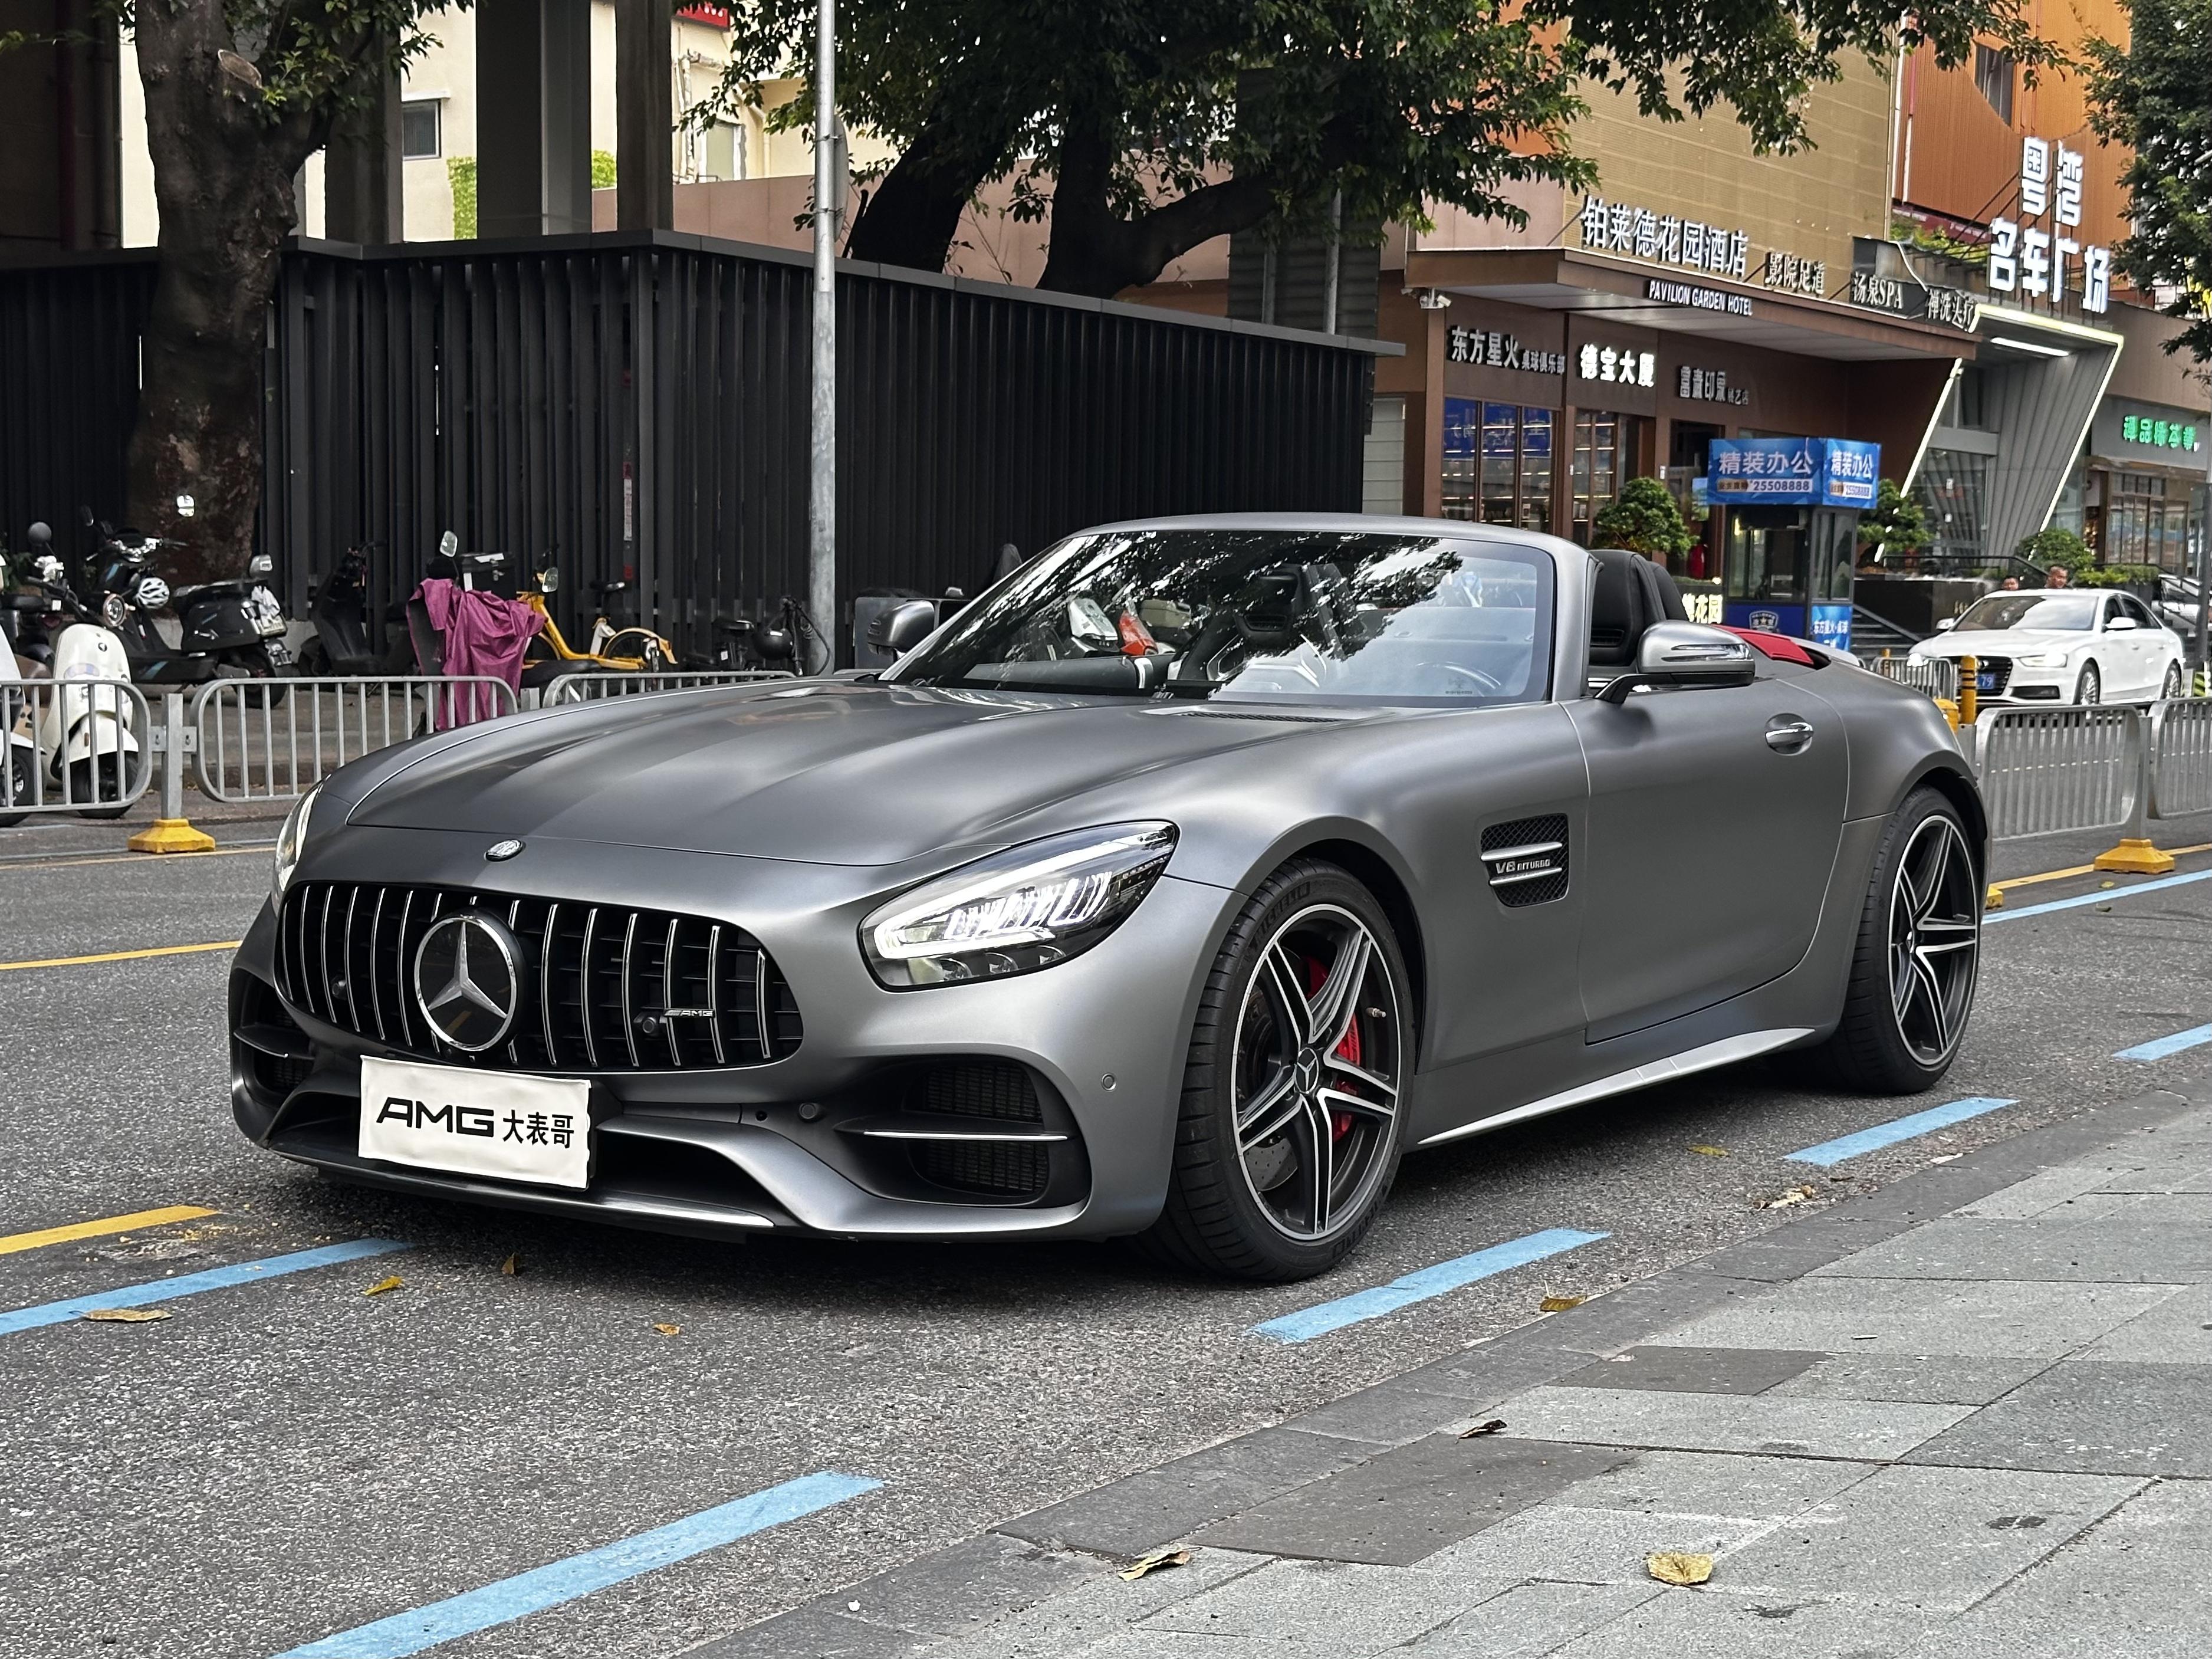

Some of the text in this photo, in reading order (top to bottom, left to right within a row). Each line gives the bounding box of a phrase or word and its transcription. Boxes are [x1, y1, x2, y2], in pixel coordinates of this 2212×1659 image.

[2022, 136, 2083, 227] 粤湾
[1584, 195, 1748, 278] 铂莱德花园酒店
[1764, 254, 1825, 294] 影院足道
[1990, 216, 2111, 314] 名车广场
[1649, 280, 1753, 316] PAVILION GARDEN HOTEL
[1451, 326, 1520, 369] 东方星火
[1718, 451, 1813, 475] 精装办公
[1831, 449, 1873, 479] 精装办公
[1753, 481, 1809, 491] 25508888
[1496, 860, 1516, 874] V8
[376, 1096, 574, 1149] AMG 大表哥
